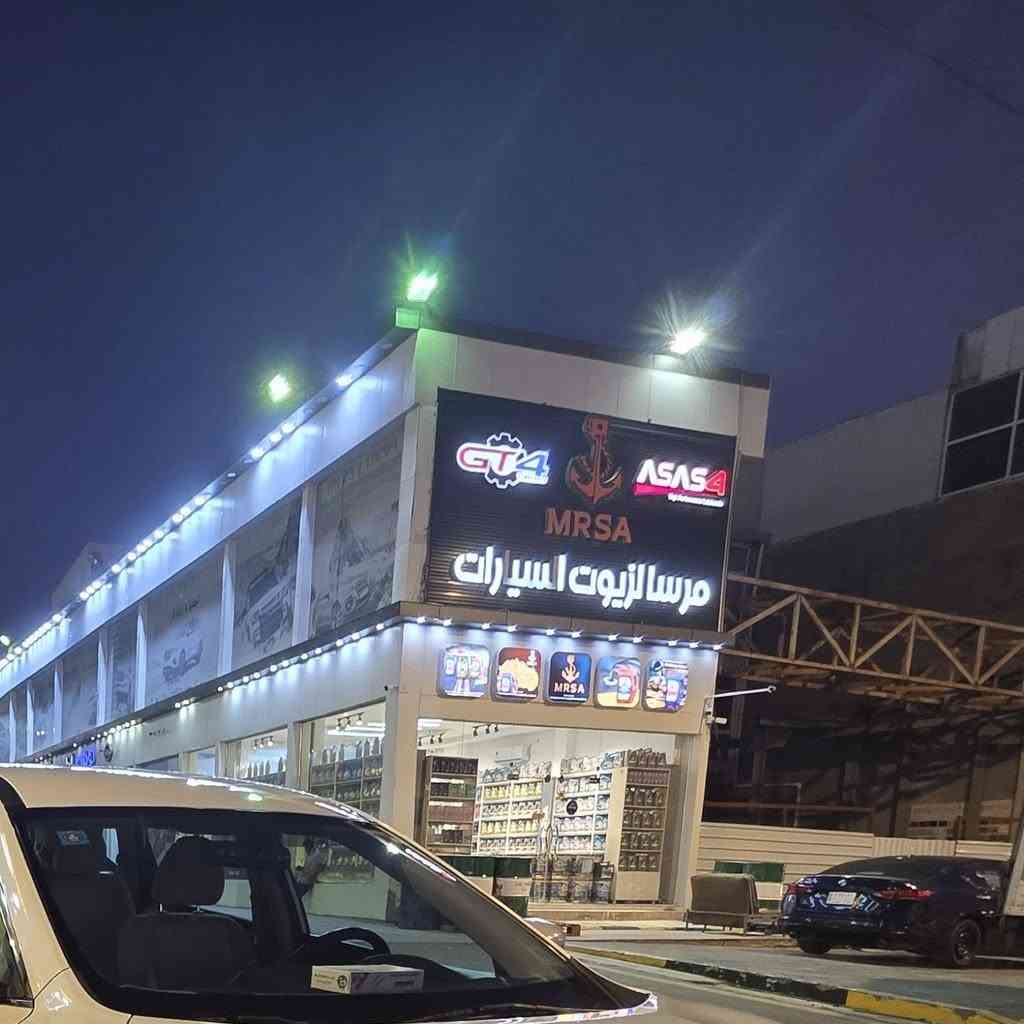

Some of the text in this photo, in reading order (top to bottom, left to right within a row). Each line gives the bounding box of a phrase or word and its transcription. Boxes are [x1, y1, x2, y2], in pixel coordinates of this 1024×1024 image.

[456, 442, 549, 477] GT4
[636, 459, 727, 496] ASAS4
[544, 507, 633, 544] MRSA
[553, 681, 585, 694] MRSA
